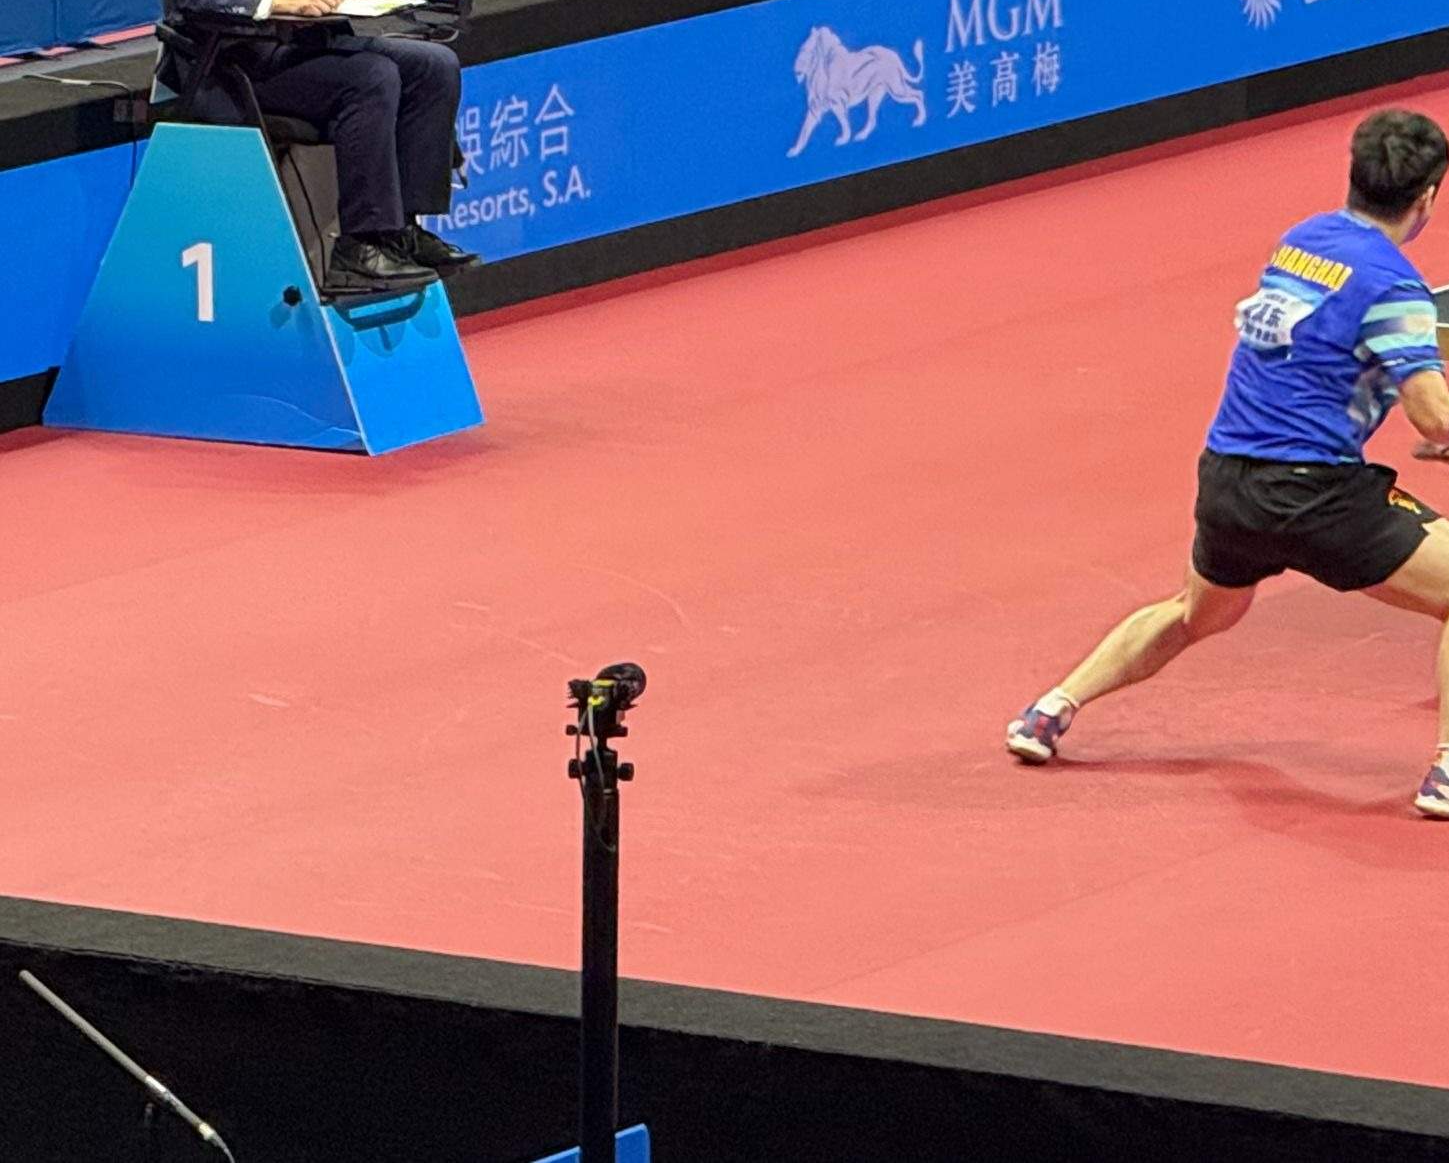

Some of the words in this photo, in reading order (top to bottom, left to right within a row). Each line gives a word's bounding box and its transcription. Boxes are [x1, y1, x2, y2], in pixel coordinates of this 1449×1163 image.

[946, 43, 1062, 119] 美高梅
[543, 164, 592, 207] S.A.
[181, 242, 214, 322] 1
